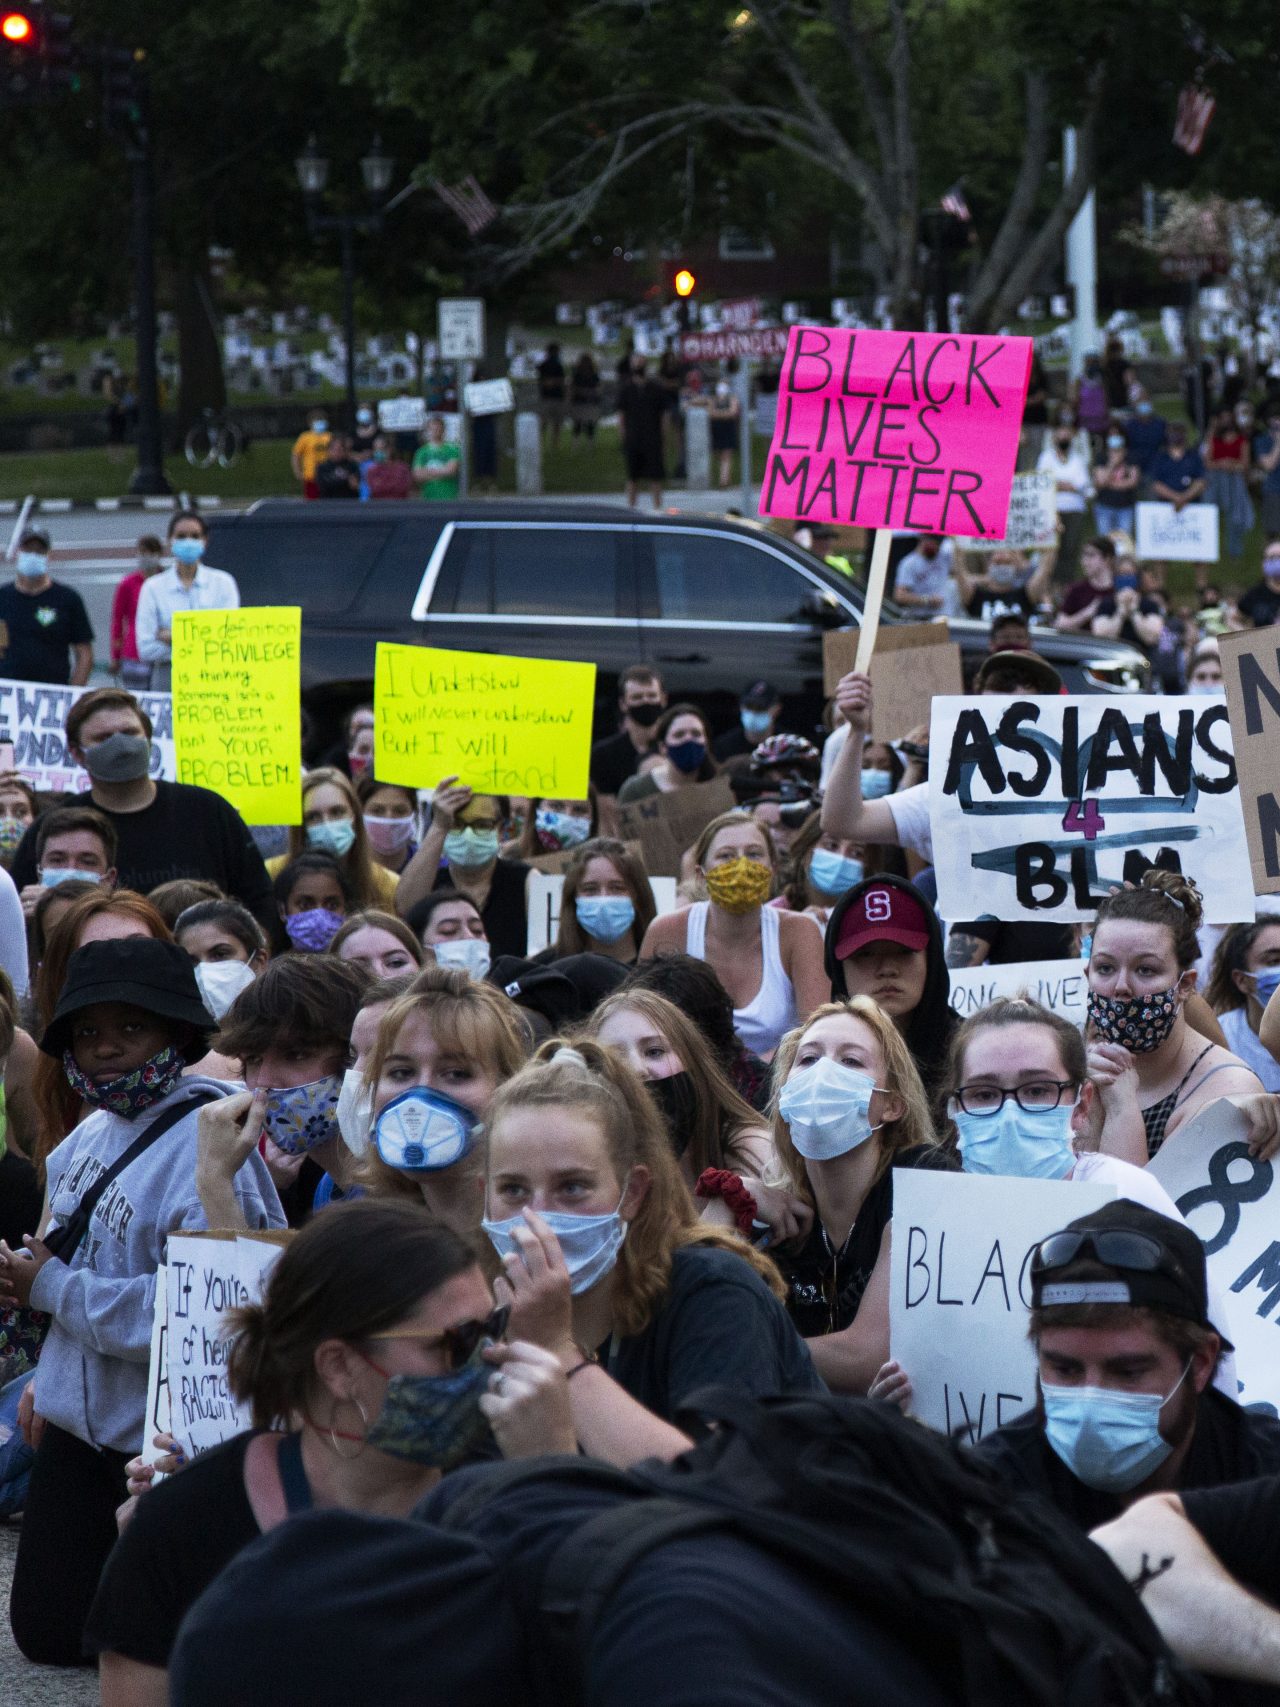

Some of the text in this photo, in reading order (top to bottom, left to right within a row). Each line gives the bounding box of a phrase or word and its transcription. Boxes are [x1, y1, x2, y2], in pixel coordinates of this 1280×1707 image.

[788, 329, 1006, 409] BLACK
[780, 396, 941, 465] LIVES
[764, 453, 996, 535] MATTER.
[175, 613, 296, 641] The definition
[204, 640, 295, 664] PRIVILEGE
[383, 651, 404, 698] I
[177, 704, 263, 723] PROBLEM
[382, 707, 389, 724] I
[218, 736, 273, 756] YOUR
[383, 730, 420, 755] But
[427, 731, 446, 756] I
[943, 701, 1238, 798] ASIANS
[180, 758, 295, 787] PROBLEM.
[1061, 798, 1105, 841] 4
[1014, 841, 1183, 911] BLM
[865, 891, 892, 922] S
[1175, 1141, 1274, 1257] 8
[172, 1262, 195, 1319] If
[182, 1324, 197, 1366] of
